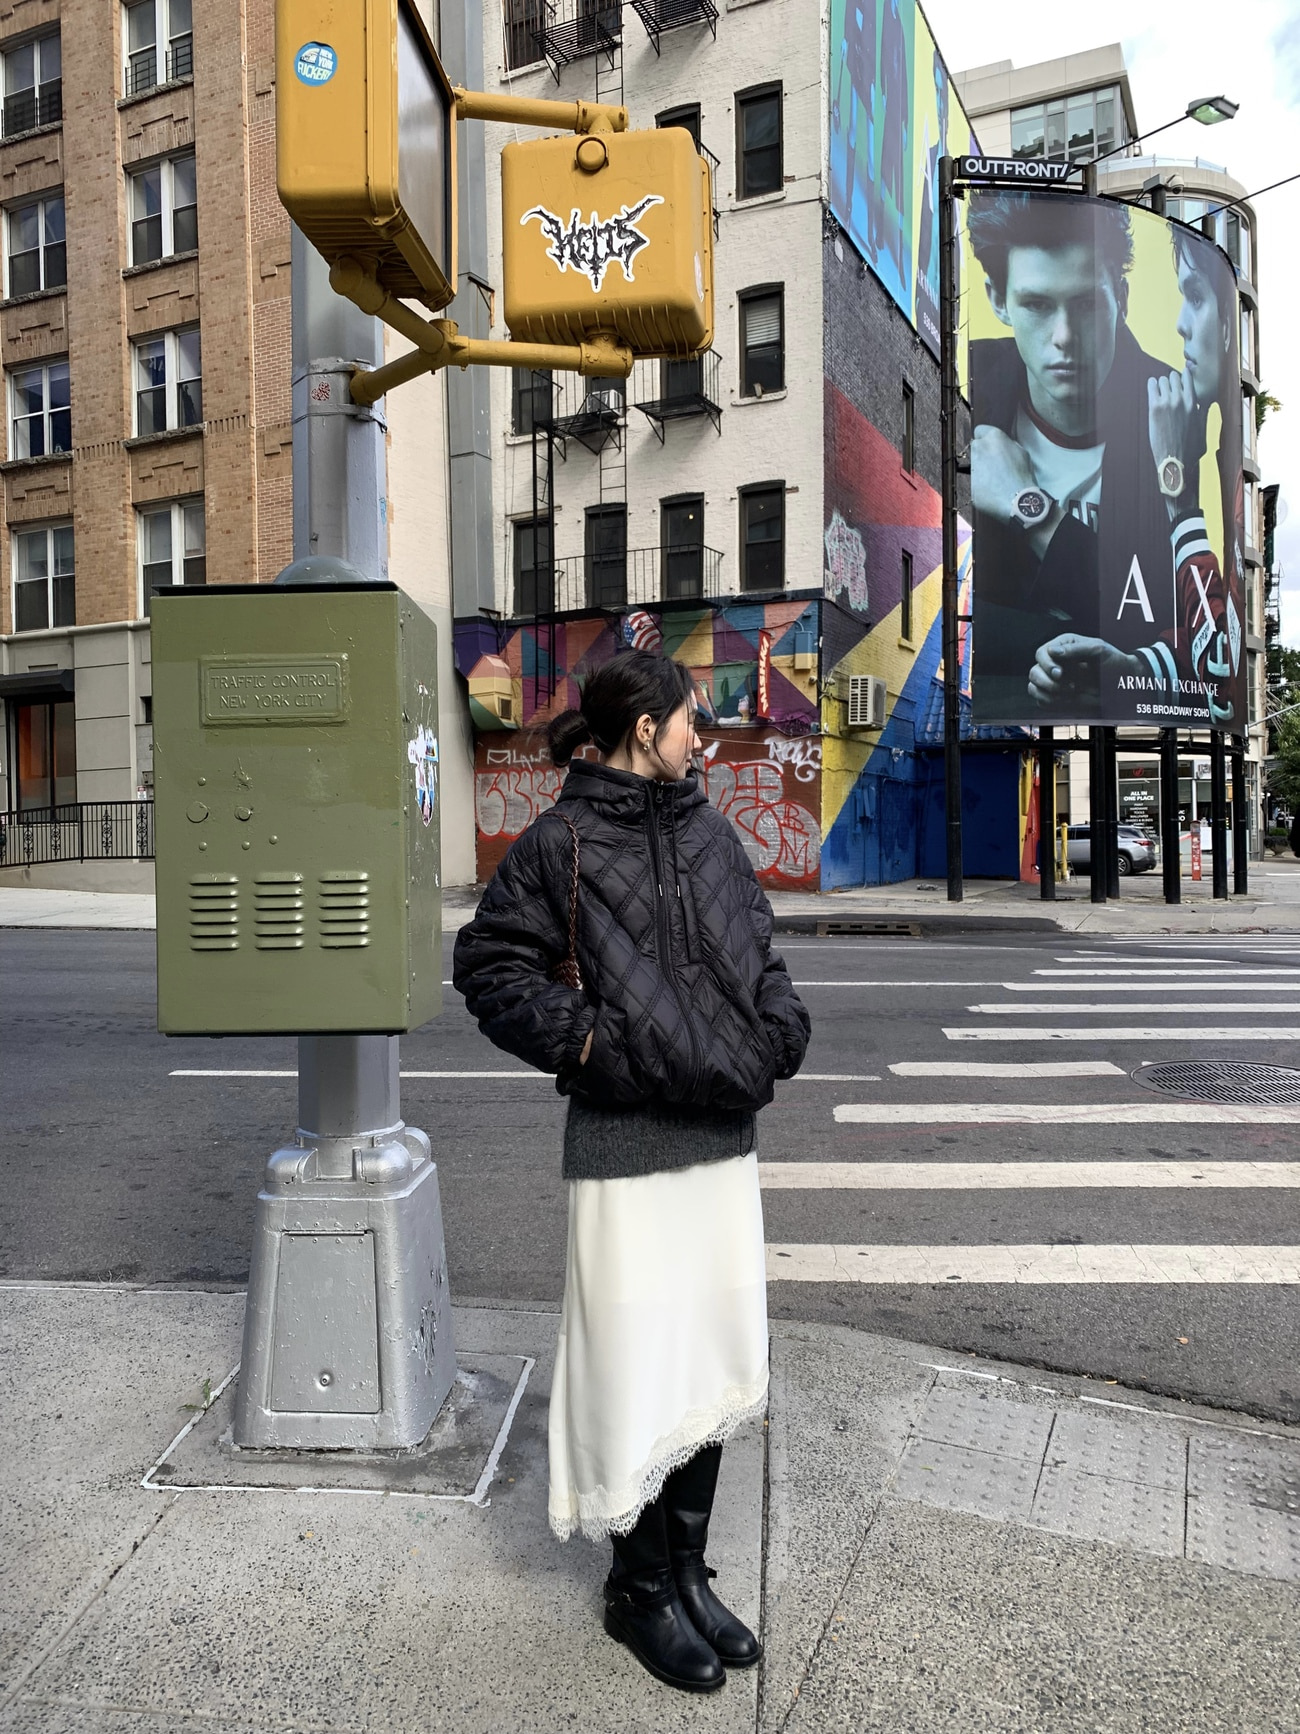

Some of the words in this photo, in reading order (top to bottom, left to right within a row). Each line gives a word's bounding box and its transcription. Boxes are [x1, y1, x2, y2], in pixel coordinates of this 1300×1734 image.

[210, 674, 267, 689] TRAFFIC
[271, 673, 335, 688] CONTROL
[1117, 675, 1167, 692] ARMANI
[1172, 679, 1219, 697] EXCHANGE
[219, 695, 249, 709] NEW
[254, 694, 290, 708] YORK
[295, 693, 327, 707] CITY
[1136, 703, 1152, 714] 536
[1152, 704, 1193, 717] BROADWAY
[1193, 708, 1210, 718] SOHO
